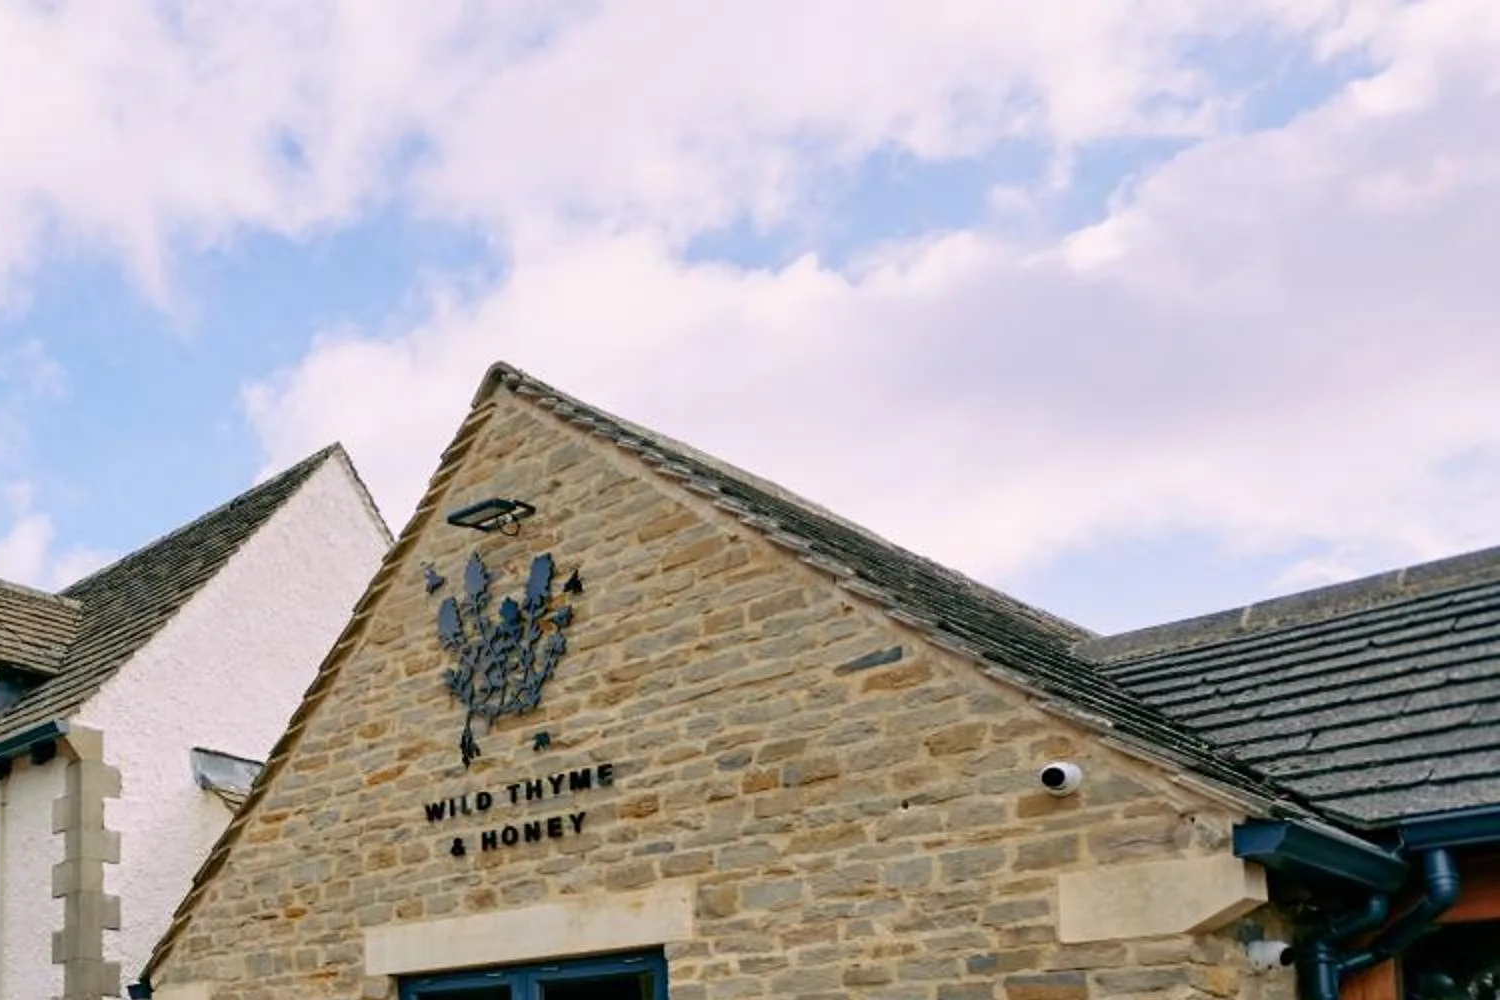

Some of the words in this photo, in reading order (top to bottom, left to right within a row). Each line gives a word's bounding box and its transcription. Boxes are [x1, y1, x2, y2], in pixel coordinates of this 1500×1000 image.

[425, 792, 492, 822] WILD
[507, 764, 613, 803] THYME
[451, 837, 466, 857] &
[482, 812, 586, 851] HONEY
